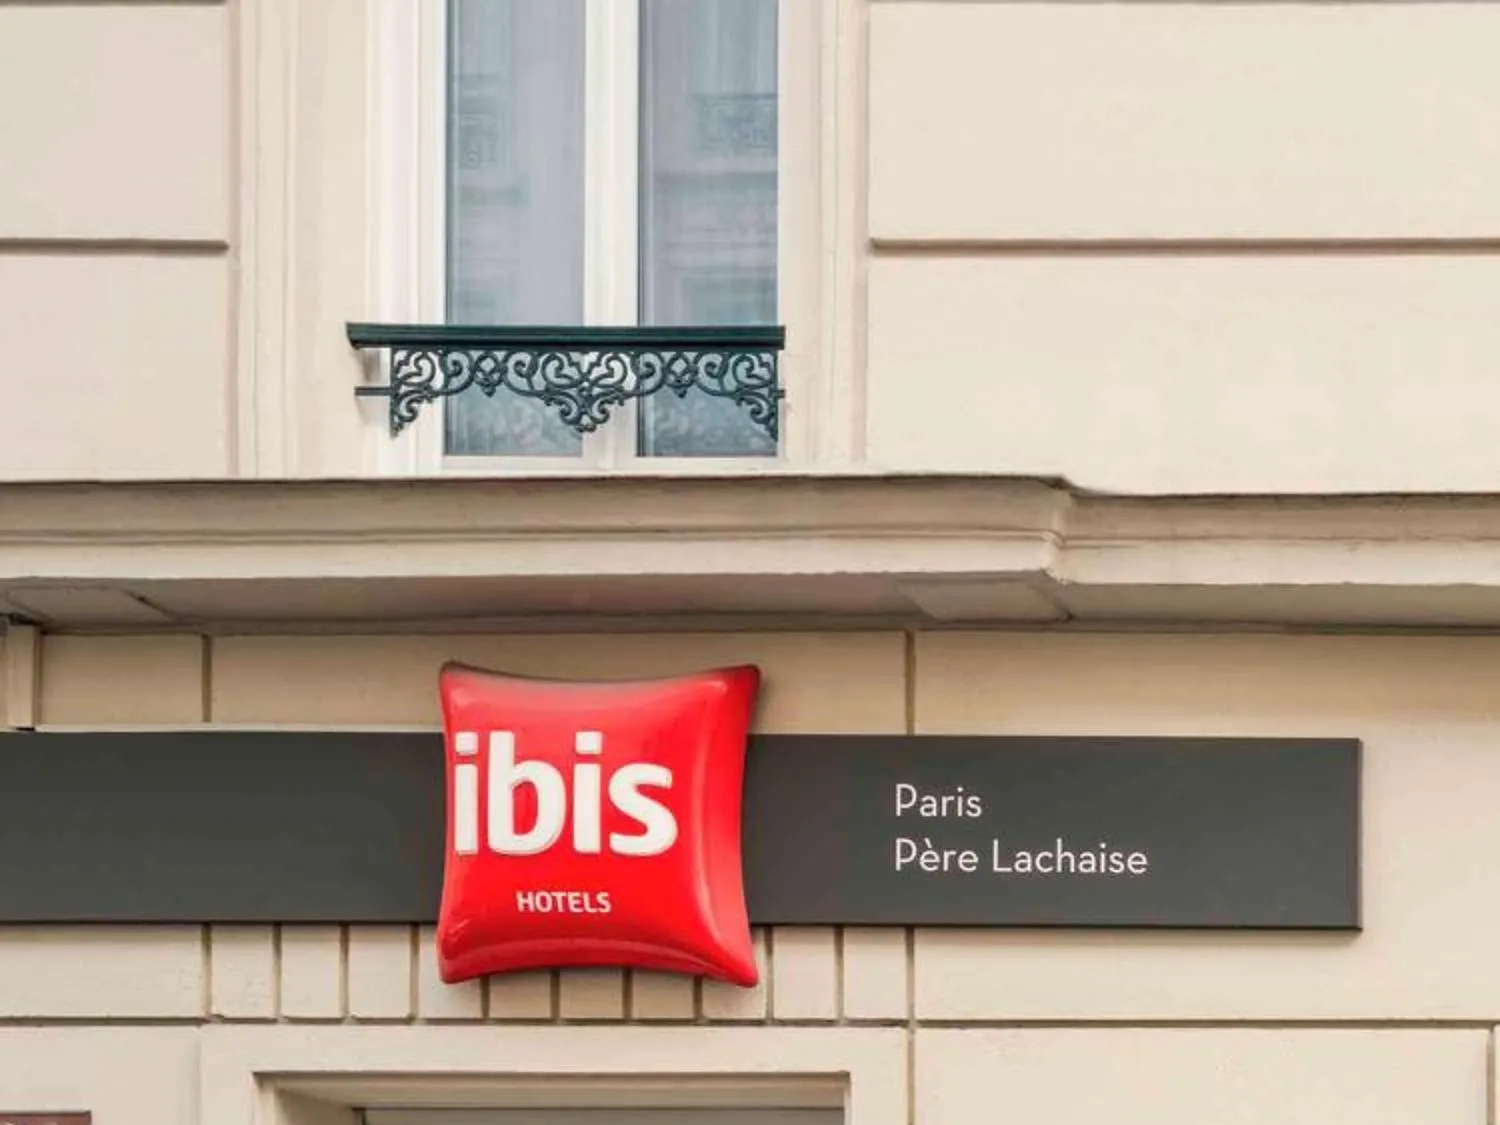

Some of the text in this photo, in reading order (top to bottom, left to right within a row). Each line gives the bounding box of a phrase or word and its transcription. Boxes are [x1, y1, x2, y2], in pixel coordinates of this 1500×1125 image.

[454, 730, 679, 857] ibis
[894, 783, 983, 819] Paris
[894, 838, 1149, 877] Père Lachaise
[516, 890, 612, 915] HOTELS
